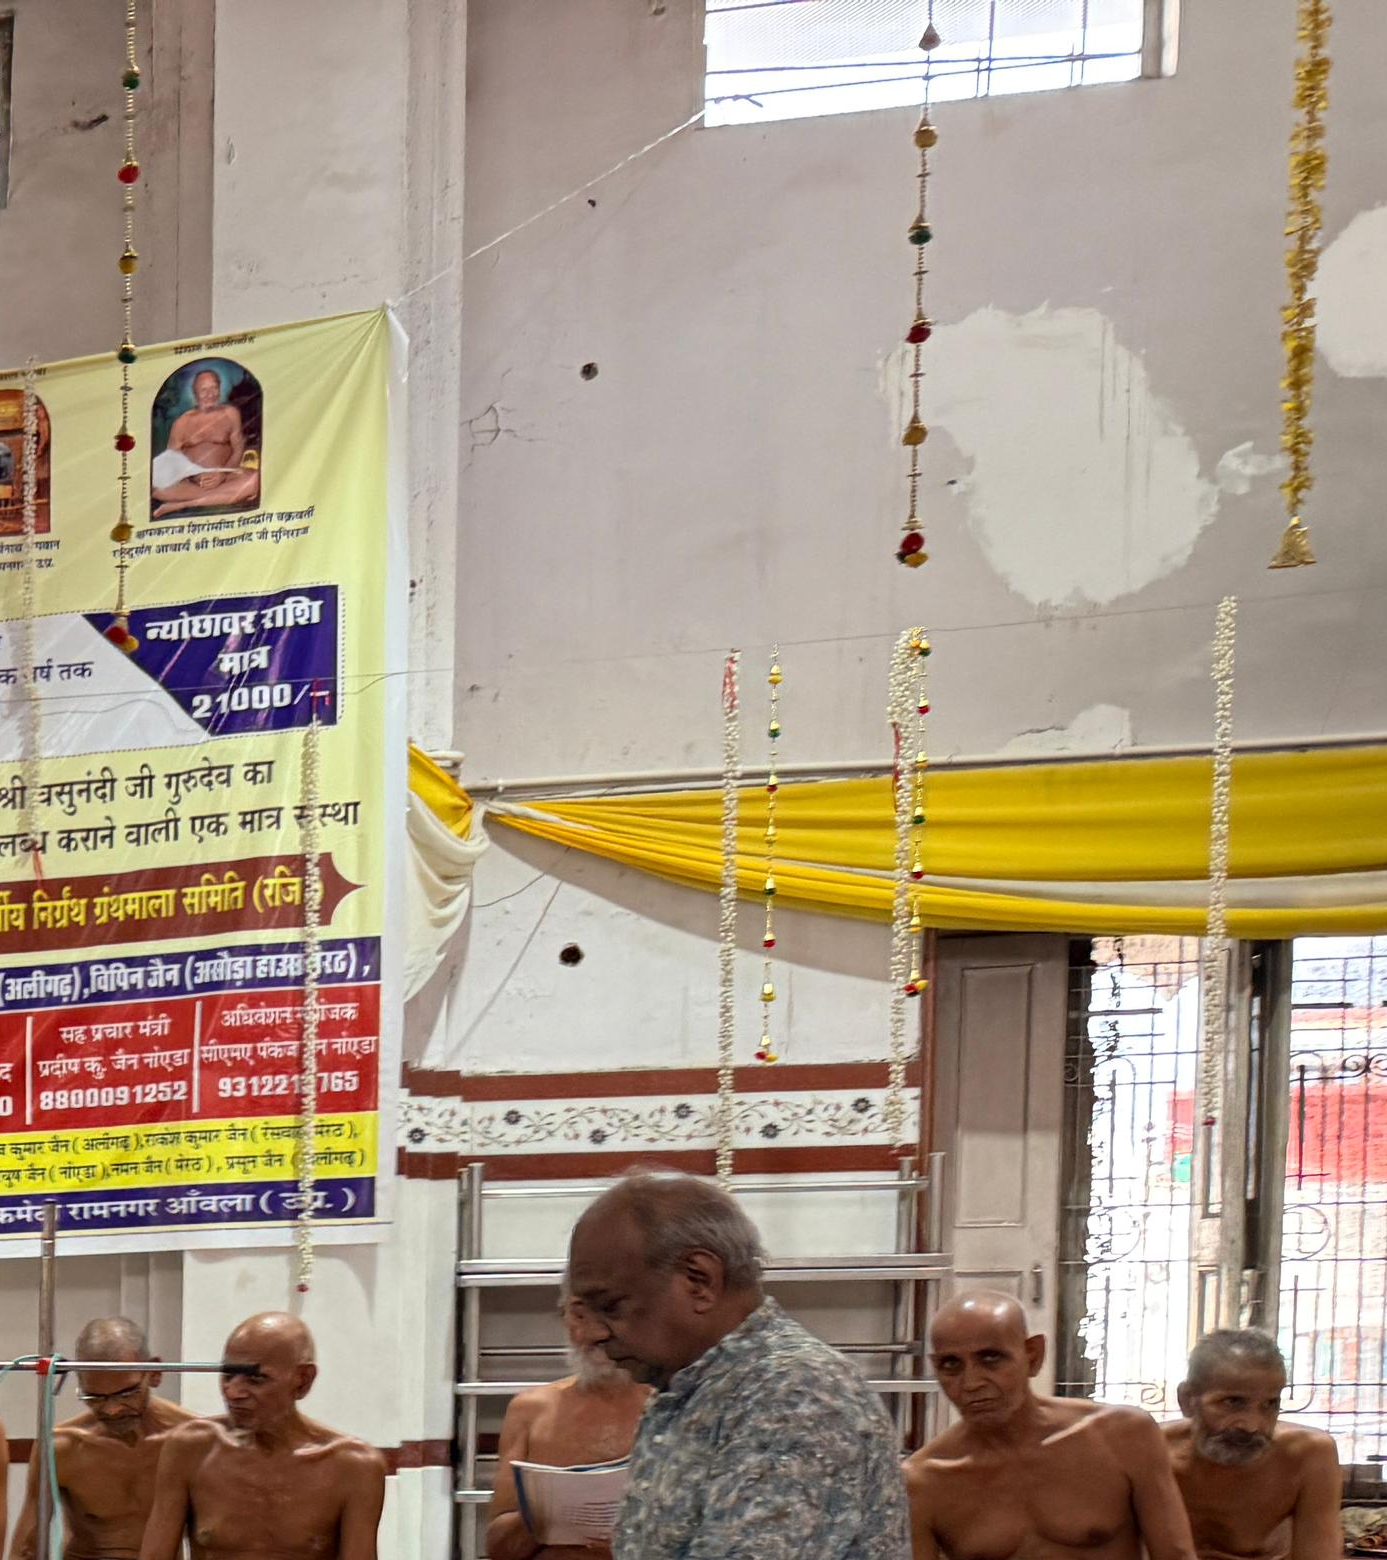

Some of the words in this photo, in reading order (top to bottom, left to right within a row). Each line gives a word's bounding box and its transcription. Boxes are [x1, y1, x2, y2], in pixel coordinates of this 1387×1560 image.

[256, 527, 268, 541] जी
[145, 610, 258, 642] न्योछावर
[260, 595, 324, 630] राशि
[57, 660, 95, 682] तक
[217, 645, 273, 676] मात्र
[38, 765, 118, 816] वसुनंदी
[125, 763, 156, 800] जी
[164, 756, 235, 805] गुरुदेव
[243, 759, 276, 786] का
[56, 815, 117, 852] कराने
[124, 806, 182, 847] वाली
[189, 811, 230, 844] एक
[237, 805, 285, 834] मात्र
[92, 885, 177, 926] ग्रंथमाला
[181, 870, 247, 916] समिति
[90, 962, 146, 994] विपिन
[146, 957, 182, 987] जैन
[58, 1025, 88, 1045] सह
[90, 1021, 135, 1043] प्रचार
[136, 1013, 172, 1038] मंत्री
[330, 1030, 379, 1061] नोएडा
[36, 1052, 82, 1079] प्रदीप
[109, 1047, 140, 1072] जैन
[141, 1045, 192, 1073] नोएडा
[39, 1080, 189, 1111] 8800091252
[218, 1070, 361, 1098] 931221765
[8, 1140, 46, 1161] कुमार
[47, 1134, 71, 1154] जैन
[183, 1128, 222, 1150] कुमार
[225, 1122, 249, 1142] जैन
[26, 1161, 47, 1182] जैन
[140, 1154, 164, 1175] जैन
[261, 1149, 286, 1168] जैन
[65, 1197, 162, 1221] रामनगर
[164, 1188, 257, 1215] आँवला
